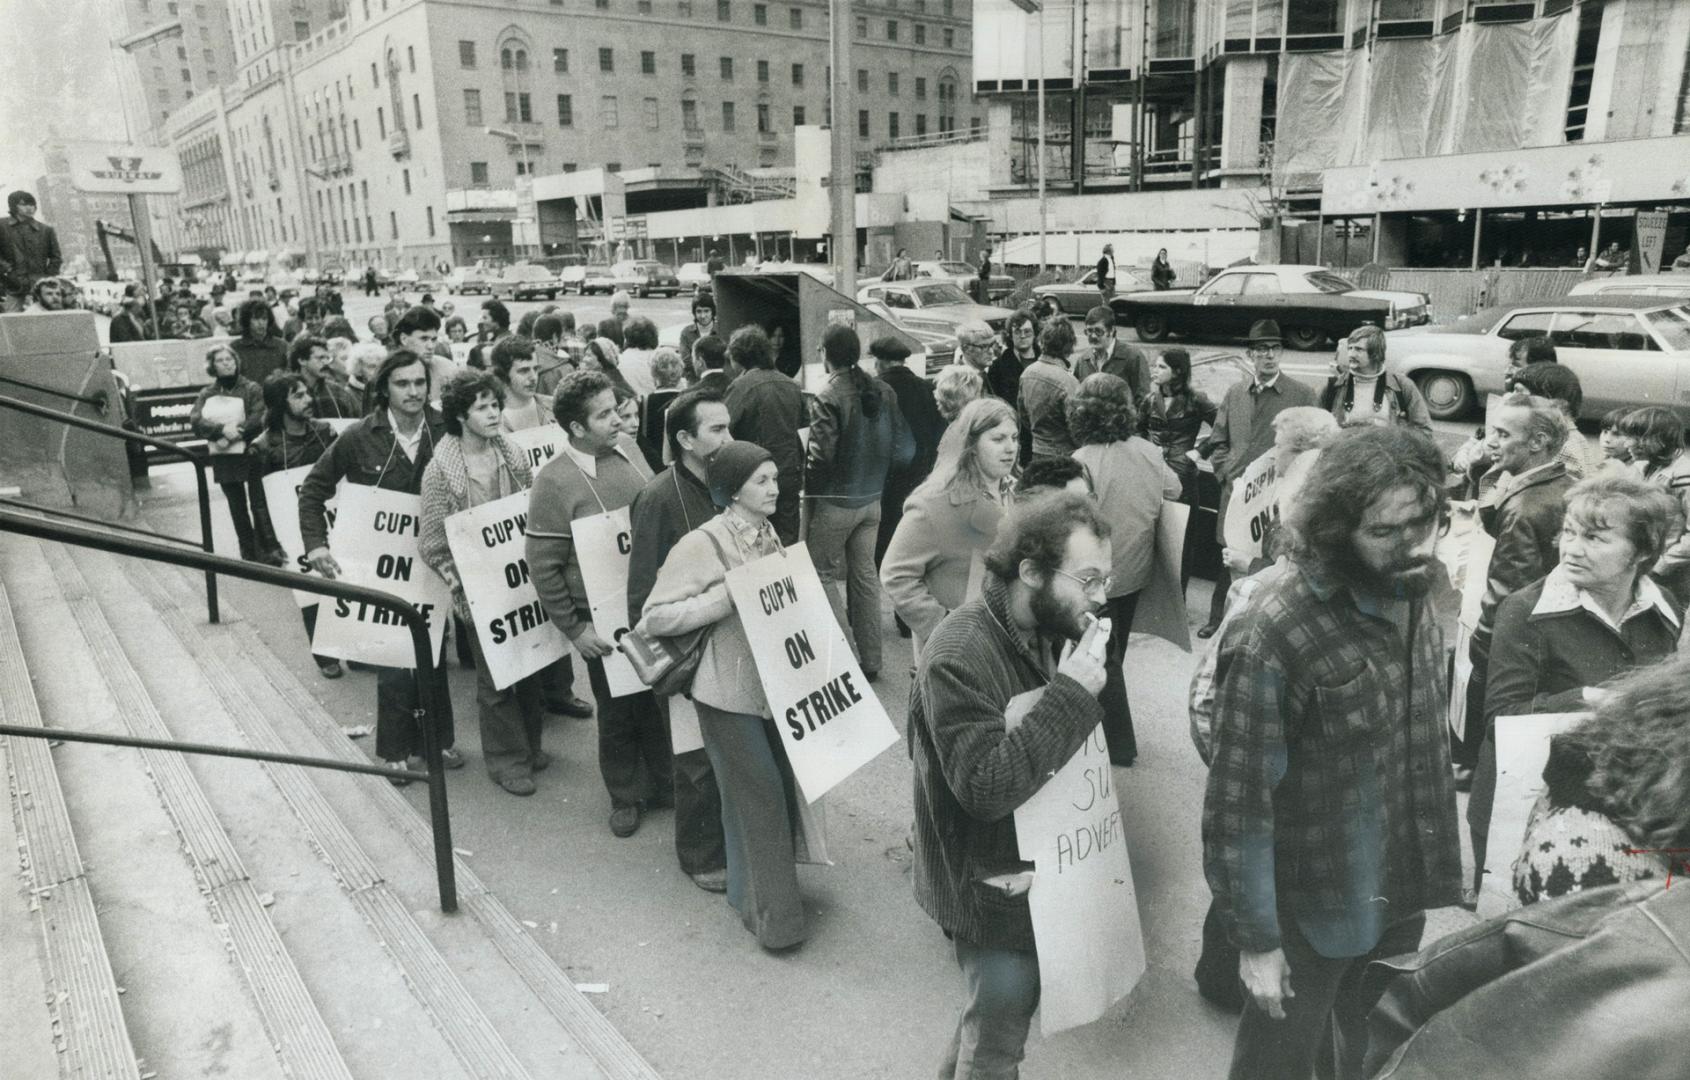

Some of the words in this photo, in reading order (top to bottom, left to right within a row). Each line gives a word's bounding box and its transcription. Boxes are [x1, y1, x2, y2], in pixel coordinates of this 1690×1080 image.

[376, 554, 413, 581] ON
[759, 575, 798, 616] CUPW
[784, 630, 816, 669] ON
[786, 672, 862, 741] STRIKE
